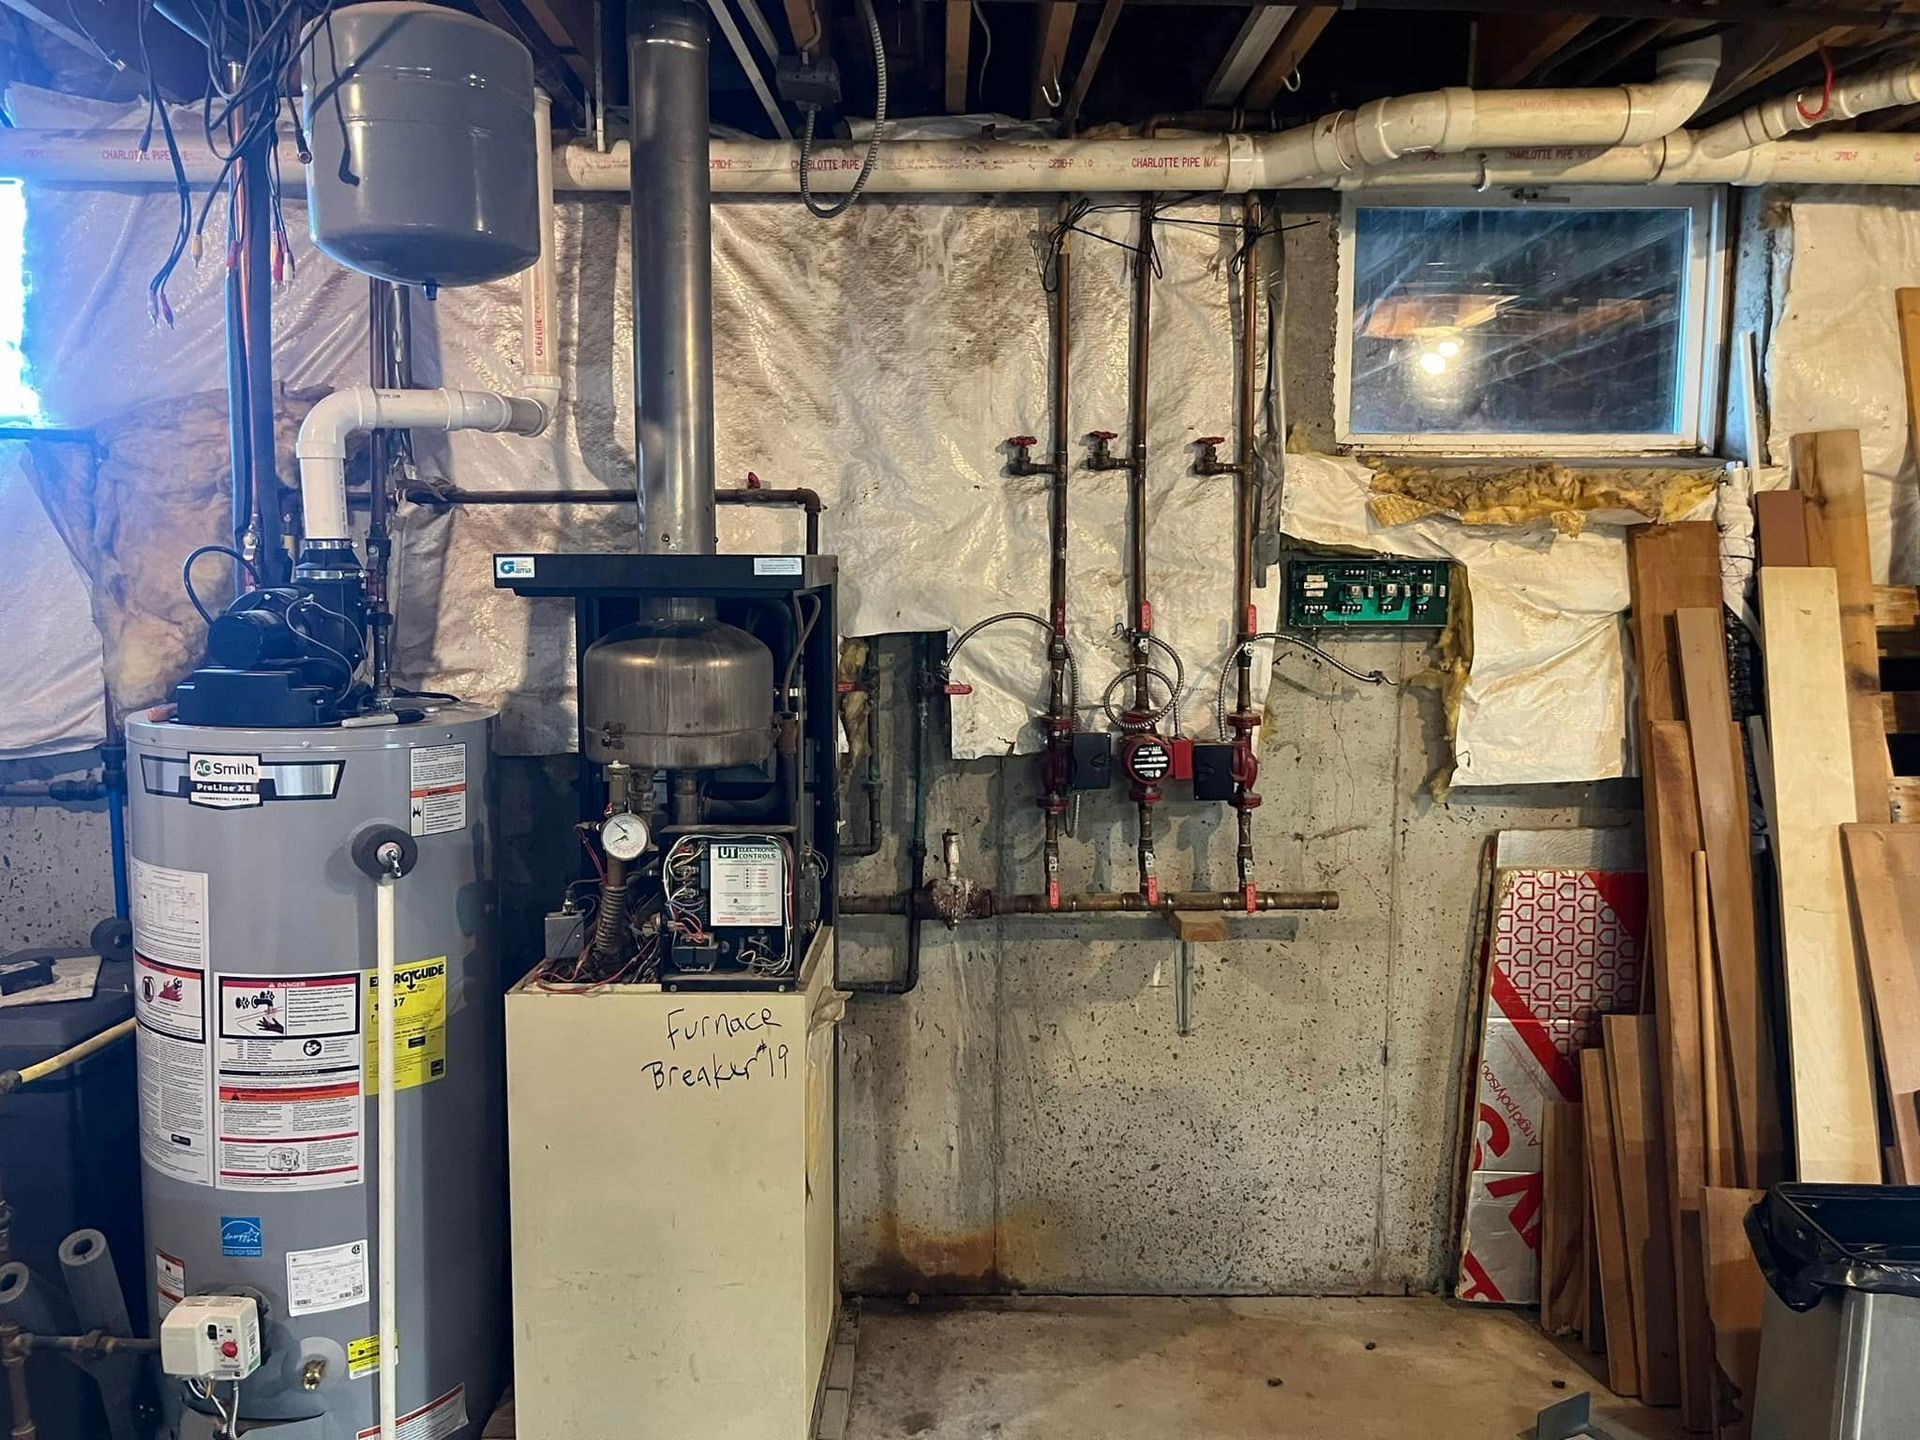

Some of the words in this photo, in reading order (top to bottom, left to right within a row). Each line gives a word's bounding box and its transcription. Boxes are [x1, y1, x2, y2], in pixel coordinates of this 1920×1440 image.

[841, 159, 860, 171] PIPE
[1131, 156, 1179, 169] CHARLOTTE
[1181, 156, 1200, 169] PIPE
[719, 846, 737, 858] UT
[667, 1008, 782, 1051] Furnace
[641, 1052, 758, 1091] Breaker
